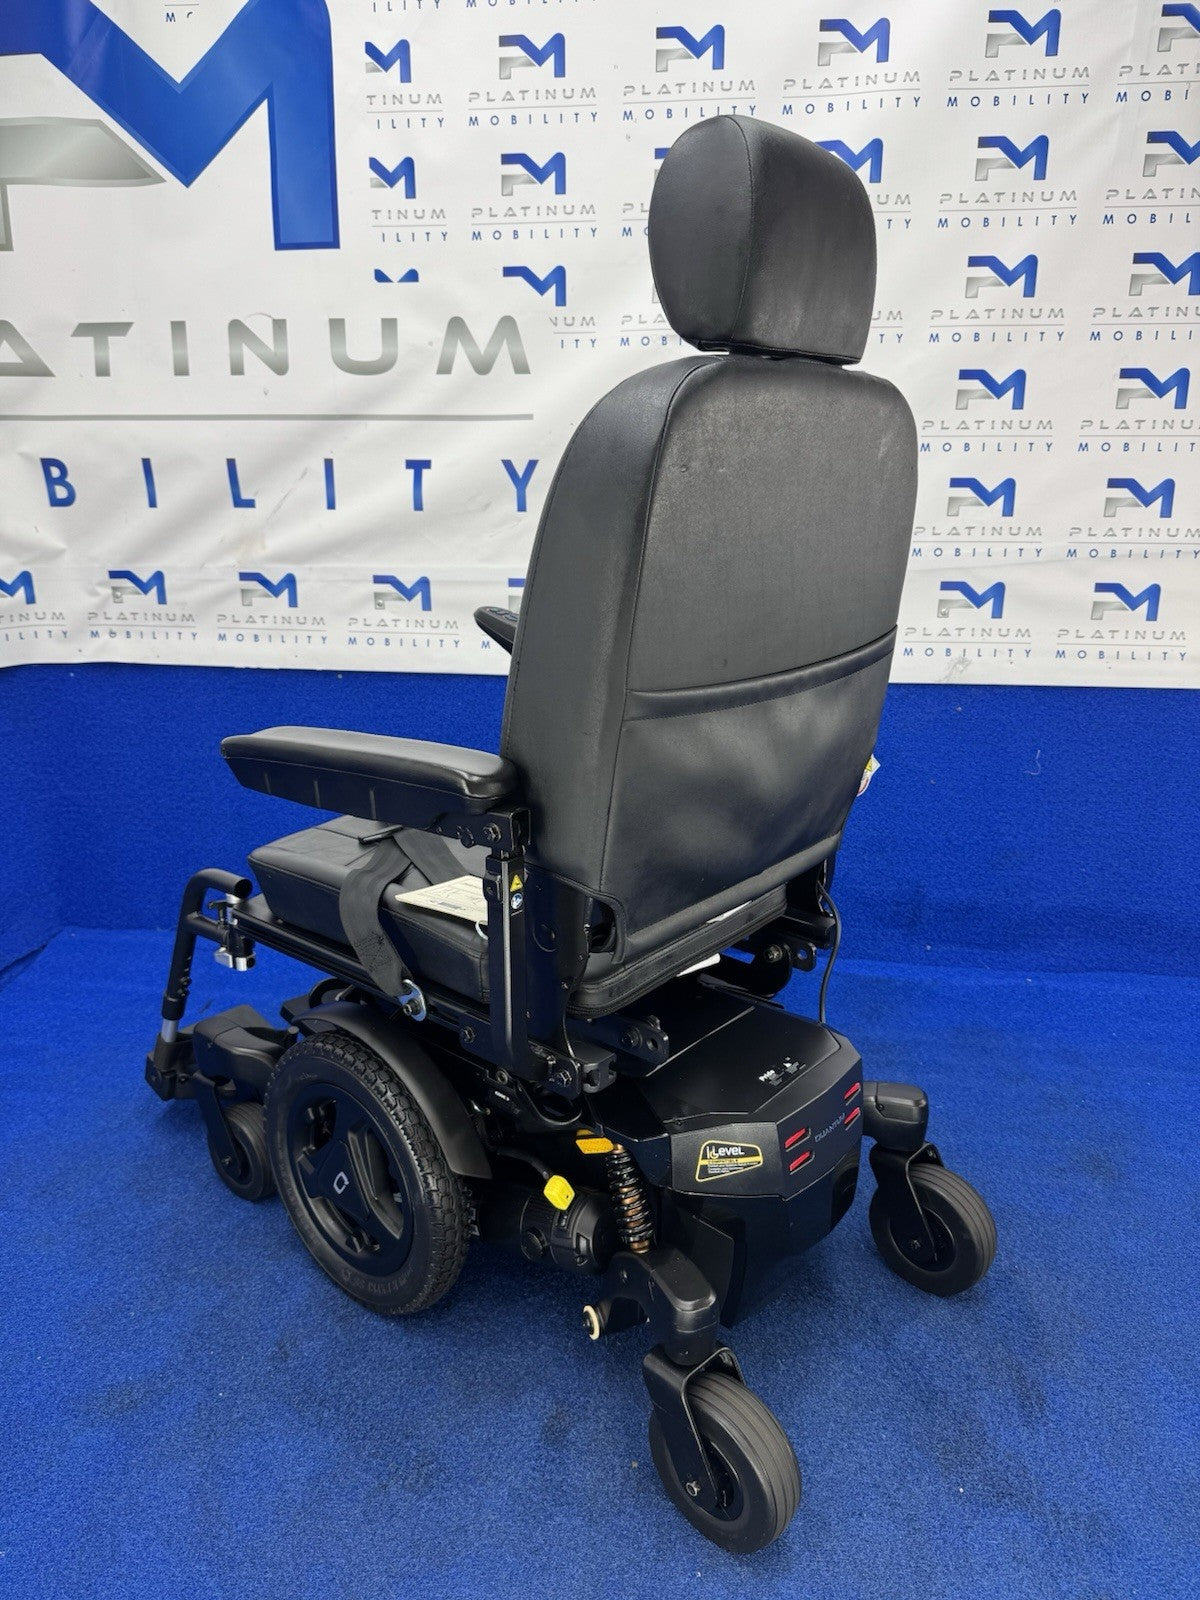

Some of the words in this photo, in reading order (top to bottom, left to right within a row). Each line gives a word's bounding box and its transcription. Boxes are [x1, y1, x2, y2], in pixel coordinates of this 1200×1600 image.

[986, 9, 1061, 57] PM
[818, 18, 890, 66] PM
[656, 25, 725, 72] PM
[499, 33, 565, 79] PM
[950, 66, 1089, 81] PLATINUM
[784, 71, 920, 90] PLATINUM
[624, 80, 755, 96] PLATINUM
[366, 94, 442, 105] TINUM
[469, 87, 596, 102] PLATINUM
[947, 93, 1089, 107] MOBILITY
[1116, 90, 1188, 102] MOBI
[782, 97, 920, 115] MOBILITY
[469, 112, 597, 126] MOBILITY
[623, 105, 756, 121] MOBILITY
[378, 118, 444, 129] ILITY
[975, 135, 1049, 181] PM
[501, 152, 566, 195] PM
[940, 190, 1077, 204] PLATINUM
[372, 209, 446, 220] TINUM
[472, 204, 595, 218] PLATINUM
[938, 215, 1077, 228] MOBILITY
[1103, 213, 1190, 224] MOBIL
[382, 232, 447, 242] ILITY
[472, 228, 597, 240] MOBILITY
[965, 254, 1038, 298] PM
[931, 308, 1064, 320] PLATINUM
[929, 332, 1064, 342] MOBILITY
[1090, 330, 1192, 341] MOBILI
[956, 369, 1026, 410] PM
[1116, 368, 1190, 409] PM
[923, 420, 1052, 430] PLATINUM
[1081, 420, 1200, 430] PLATINU
[920, 443, 1052, 452] MOBILITY
[1078, 442, 1195, 452] MOBILIT
[947, 478, 1016, 517] PM
[1103, 478, 1175, 518] PM
[914, 526, 1042, 537] PLATINUM
[912, 548, 1042, 558] MOBILITY
[239, 572, 298, 607] PM
[1091, 583, 1161, 621] PM
[87, 612, 194, 622] PLATINUM
[217, 614, 325, 625] PLATINUM
[348, 617, 458, 629] PLATINUM
[90, 629, 197, 639] MOBILITY
[218, 633, 326, 644] MOBILITY
[905, 627, 1031, 638] PLATINUM
[1057, 629, 1186, 640] PLATINUM
[348, 637, 459, 648] MOBILITY
[904, 648, 1031, 657] MOBILITY
[1055, 650, 1186, 661] MOBILITY
